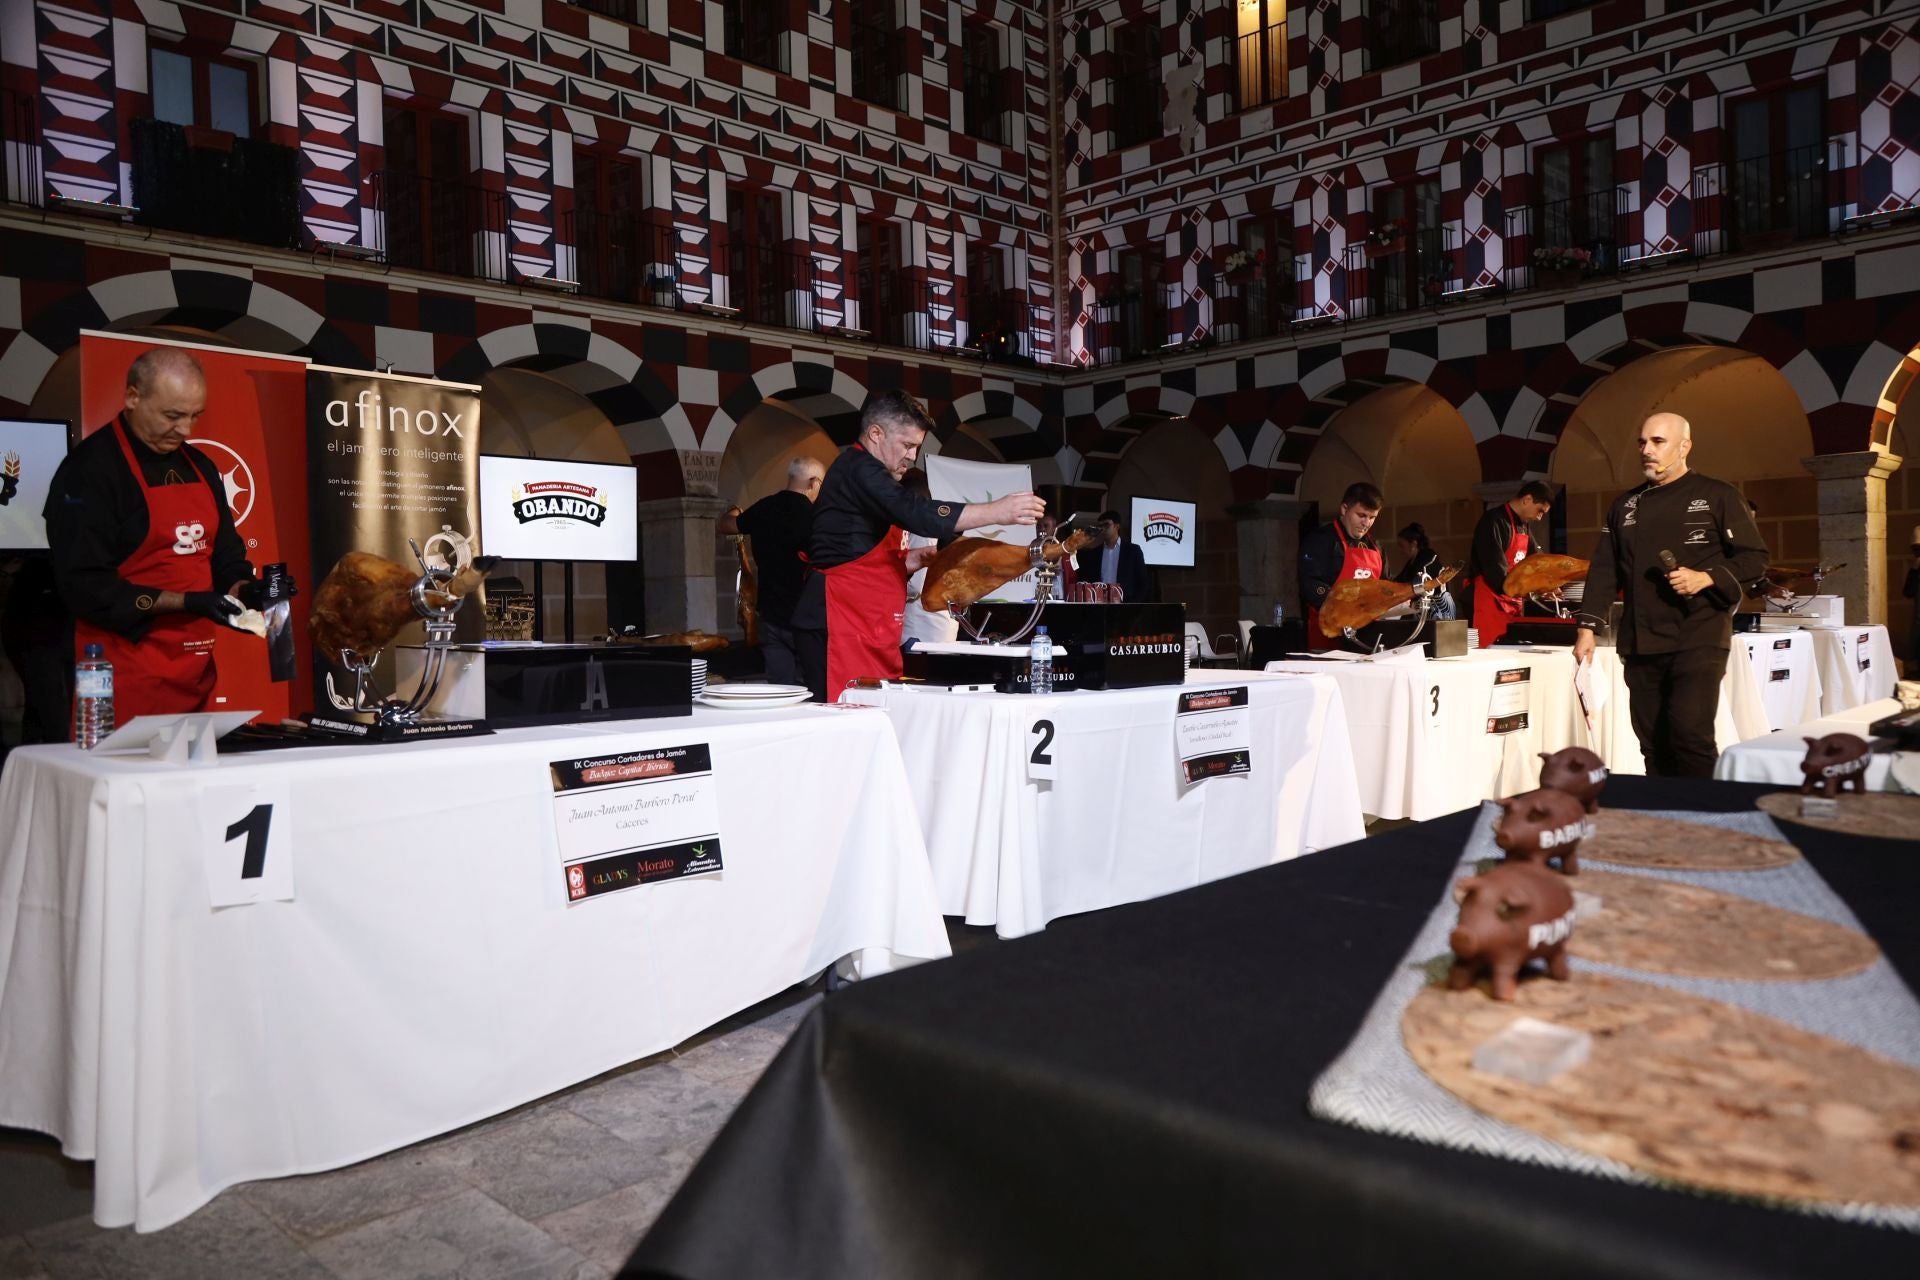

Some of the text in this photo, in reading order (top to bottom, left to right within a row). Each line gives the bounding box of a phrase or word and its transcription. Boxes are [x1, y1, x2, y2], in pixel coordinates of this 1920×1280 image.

[325, 390, 464, 438] afinox
[327, 440, 339, 452] el
[341, 440, 400, 457] jamero
[521, 497, 599, 521] OBANDO
[1147, 523, 1180, 540] OBANDO
[1110, 643, 1181, 656] CASARRUBIO
[1430, 685, 1440, 717] 3
[403, 727, 420, 735] Juan
[420, 725, 446, 733] Antonio
[1030, 719, 1055, 765] 2
[574, 748, 687, 769] IX Concurso Cortadores de Jamón
[224, 803, 274, 880] 1
[637, 859, 674, 873] Morato
[592, 869, 628, 885] GLADYS
